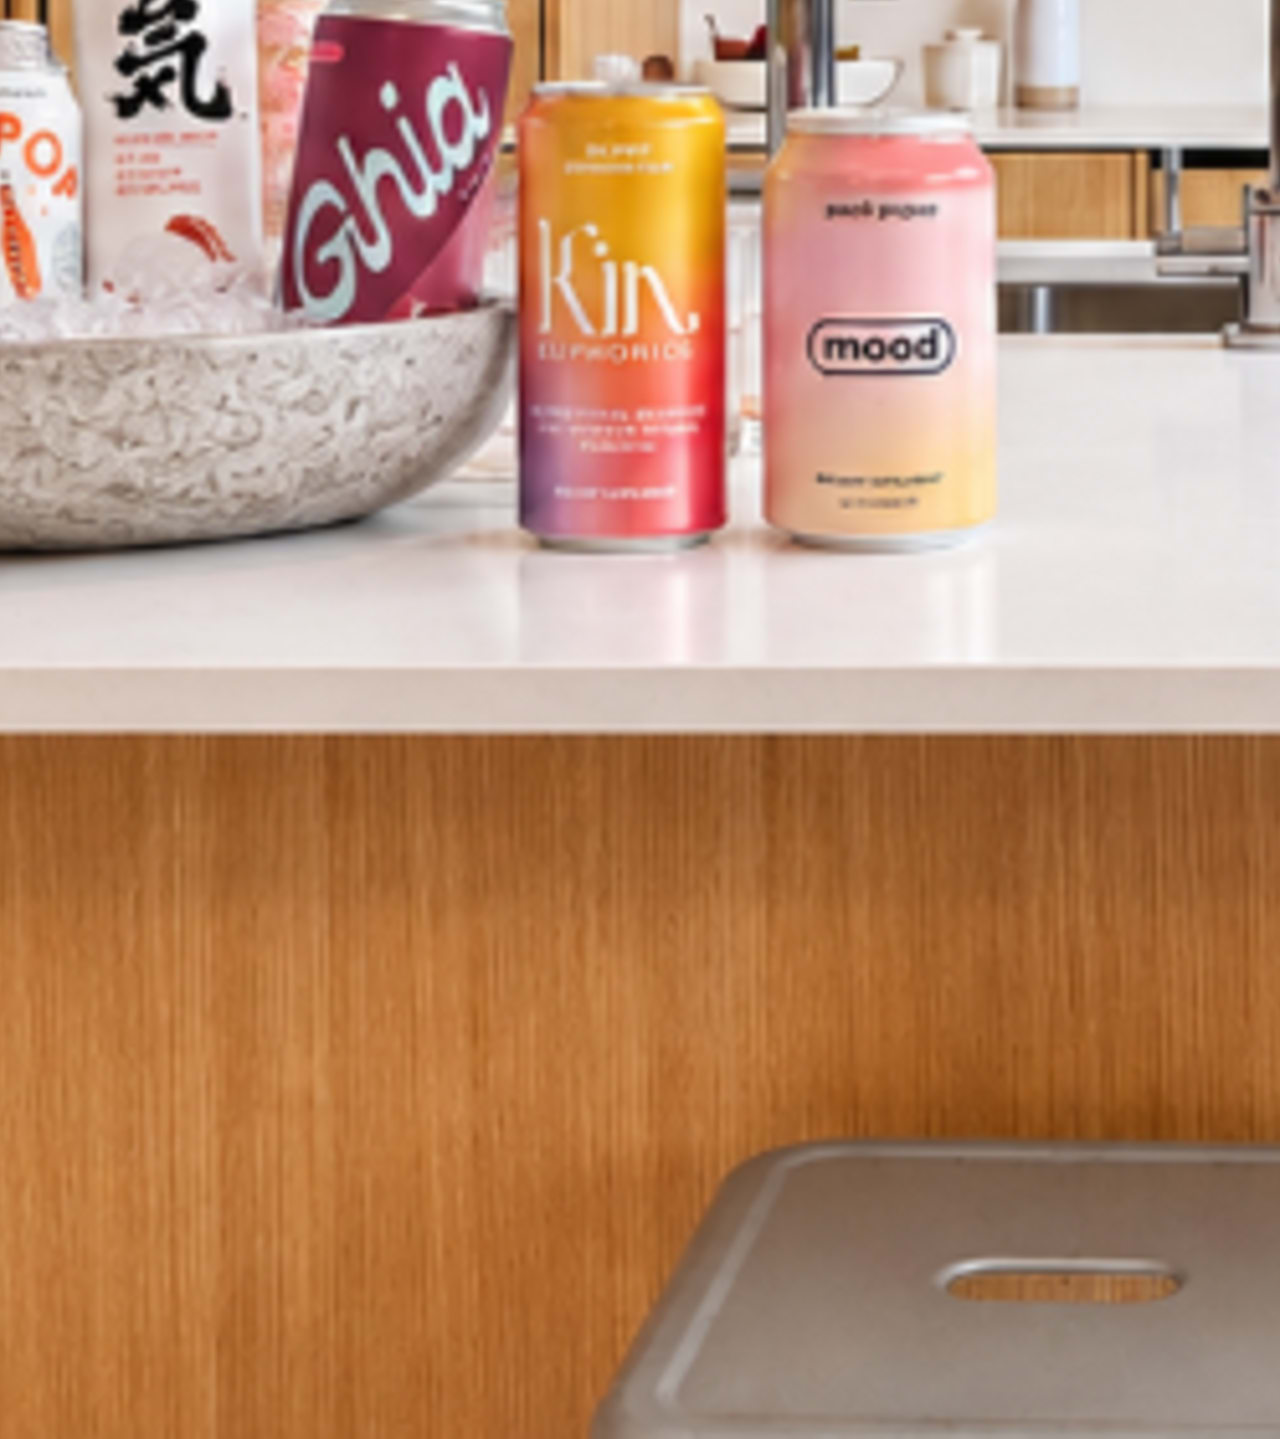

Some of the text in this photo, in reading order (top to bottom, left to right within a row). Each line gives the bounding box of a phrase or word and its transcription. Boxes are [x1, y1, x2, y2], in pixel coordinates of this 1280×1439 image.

[293, 61, 491, 323] Ghia
[537, 216, 701, 337] Kin
[823, 328, 939, 362] mood
